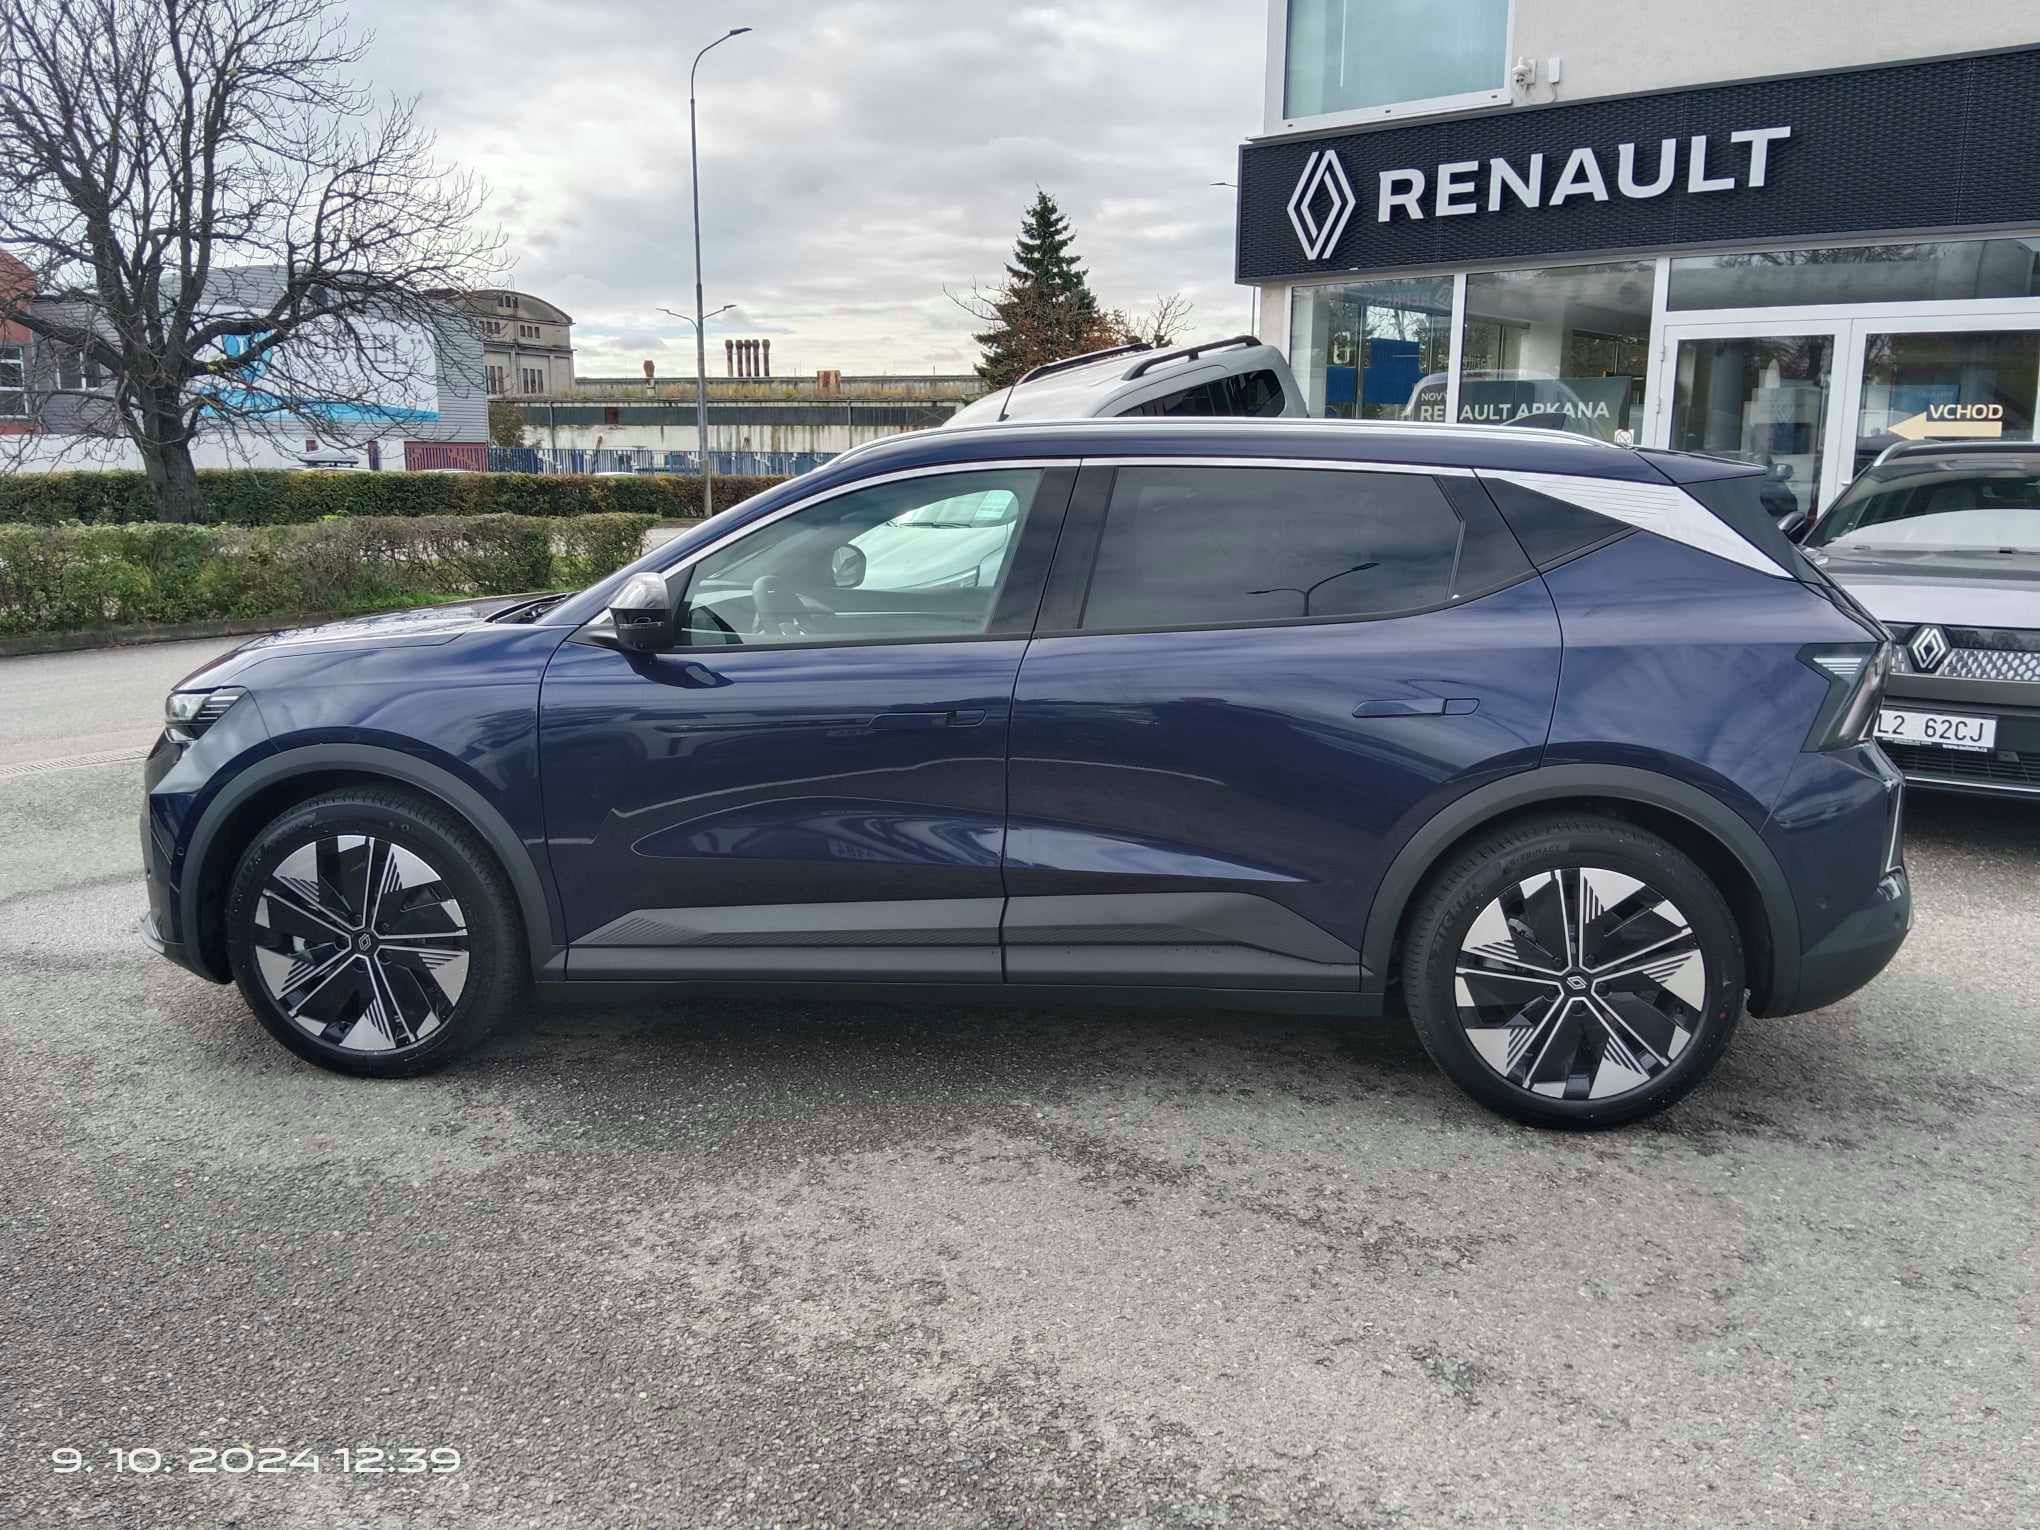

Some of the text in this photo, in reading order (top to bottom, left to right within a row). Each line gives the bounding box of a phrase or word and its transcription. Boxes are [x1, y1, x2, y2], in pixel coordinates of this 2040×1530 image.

[1377, 126, 1792, 223] RENAULT
[1929, 404, 2004, 420] VCHOD
[1924, 718, 1984, 743] 62CJ
